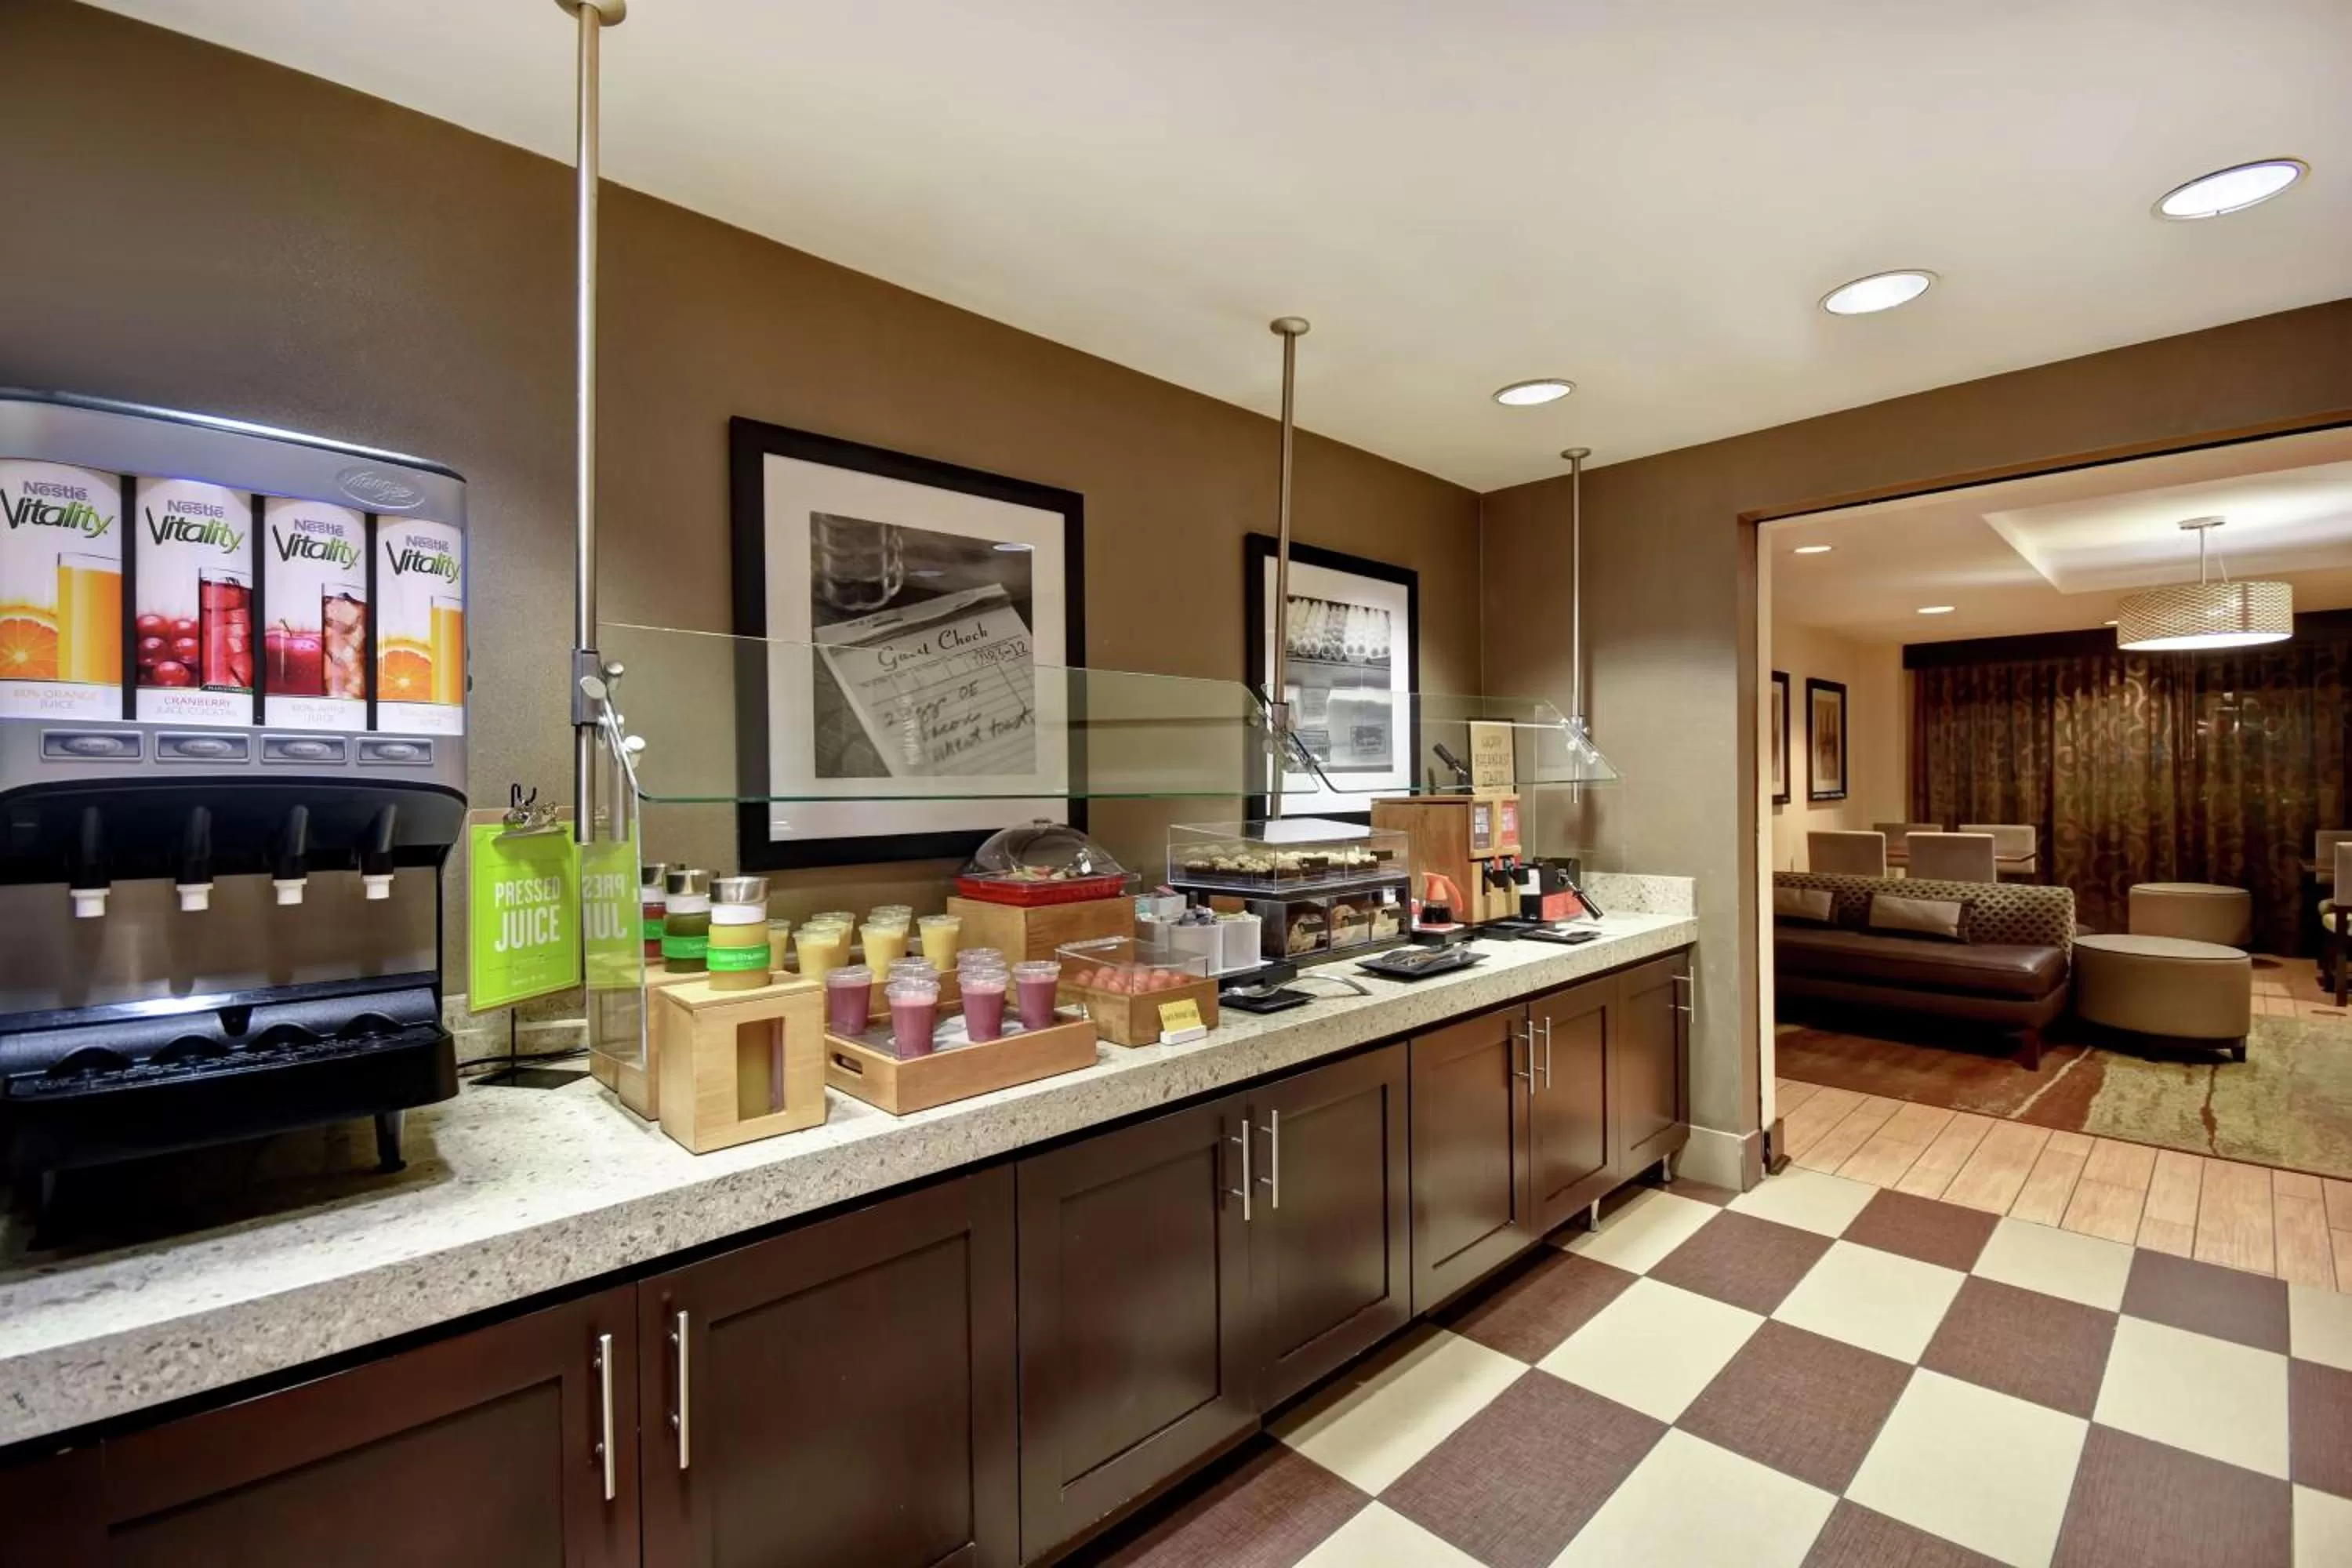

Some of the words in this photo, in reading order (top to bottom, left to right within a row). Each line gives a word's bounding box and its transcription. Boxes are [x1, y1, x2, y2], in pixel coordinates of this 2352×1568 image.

[0, 488, 114, 539] Vitality
[145, 505, 245, 554] Vitality
[272, 524, 361, 571] Vitality
[385, 539, 461, 584] Vitality
[494, 876, 561, 909] PRESSED
[494, 904, 561, 953] JUICE
